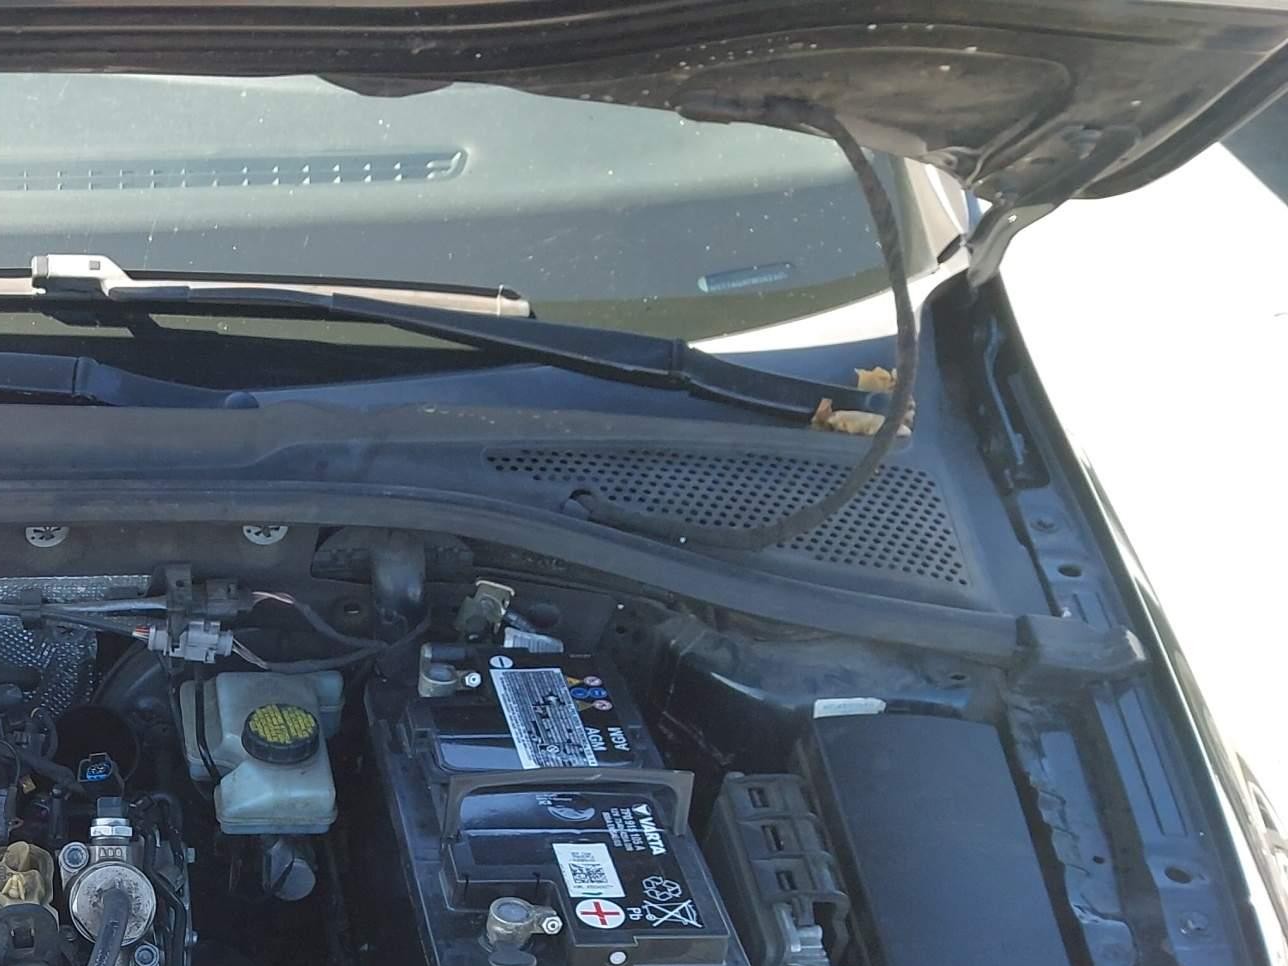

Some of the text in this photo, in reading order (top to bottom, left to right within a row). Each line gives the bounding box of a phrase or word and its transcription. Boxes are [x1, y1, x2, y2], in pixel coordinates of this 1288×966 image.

[585, 727, 607, 751] AGM
[608, 727, 630, 751] AGM
[639, 817, 666, 855] VARTA
[627, 907, 642, 921] Pb
